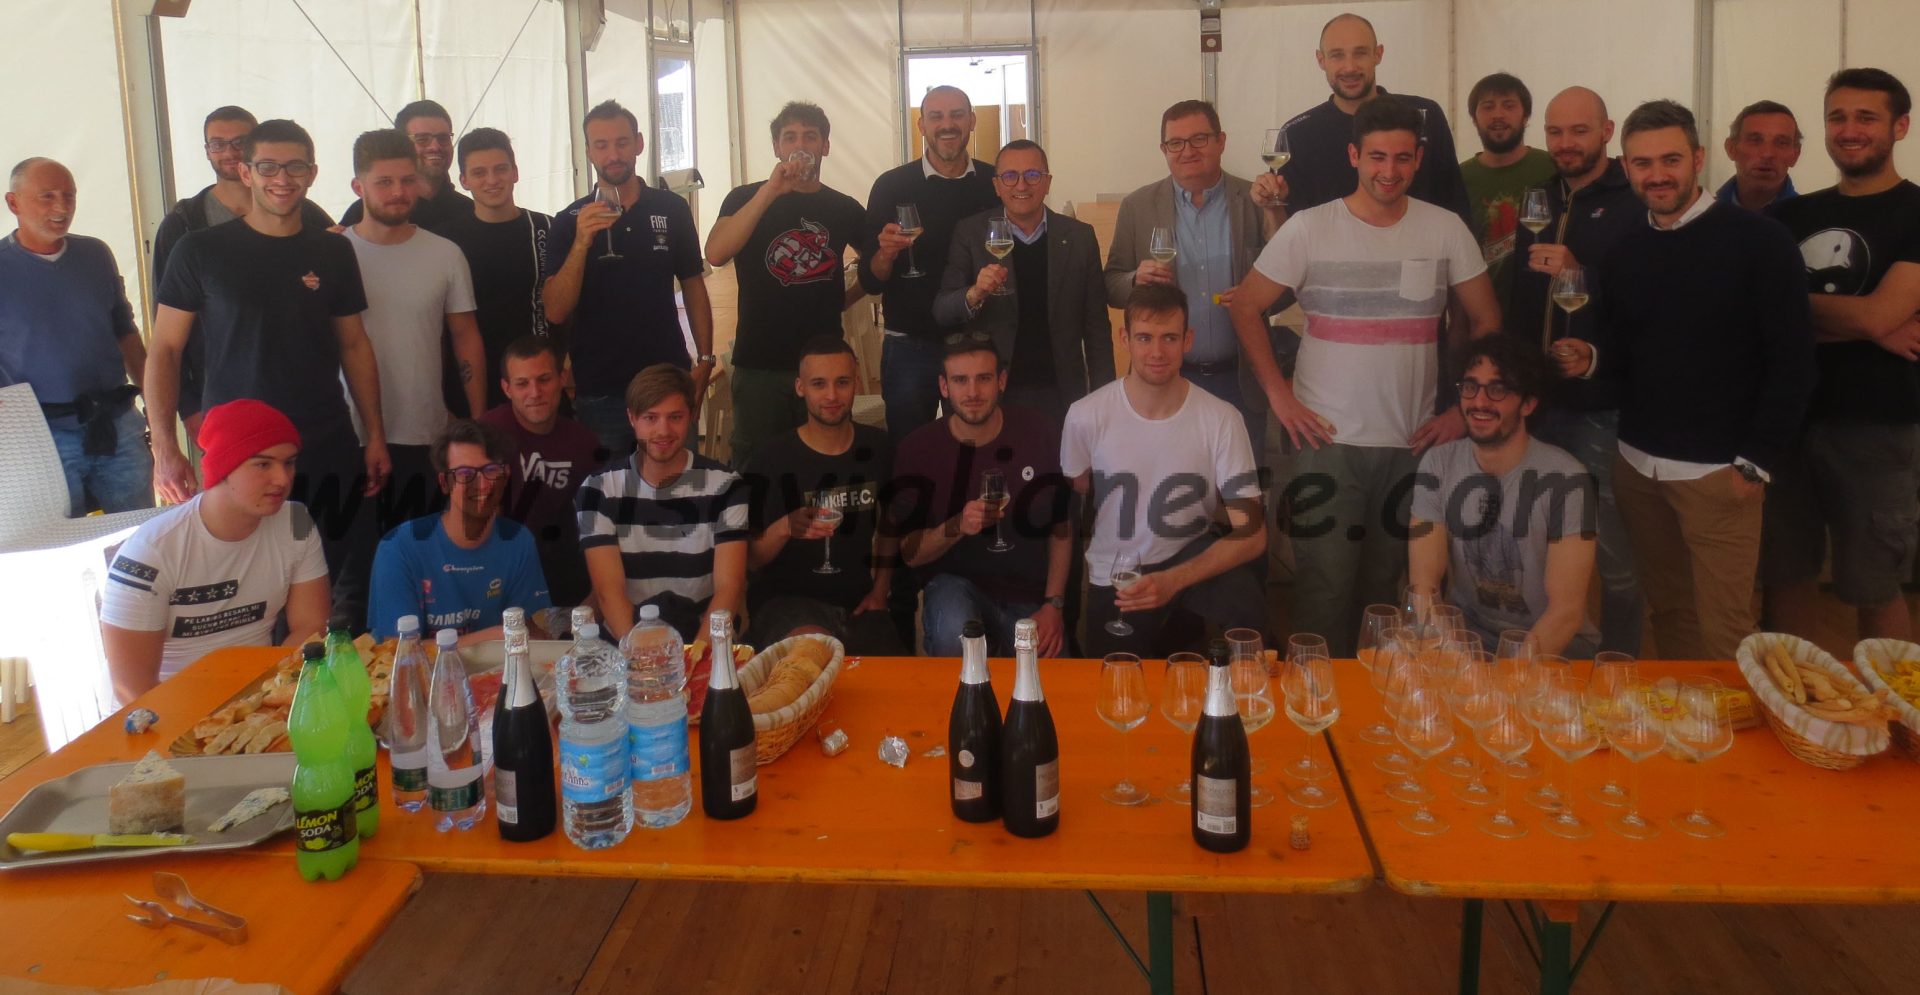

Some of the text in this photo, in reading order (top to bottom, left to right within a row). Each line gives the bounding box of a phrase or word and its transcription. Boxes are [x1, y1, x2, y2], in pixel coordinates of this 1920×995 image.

[650, 215, 667, 229] FIAT
[850, 489, 875, 506] F.C.
[427, 608, 481, 626] SAMSNG
[300, 824, 332, 838] SODA
